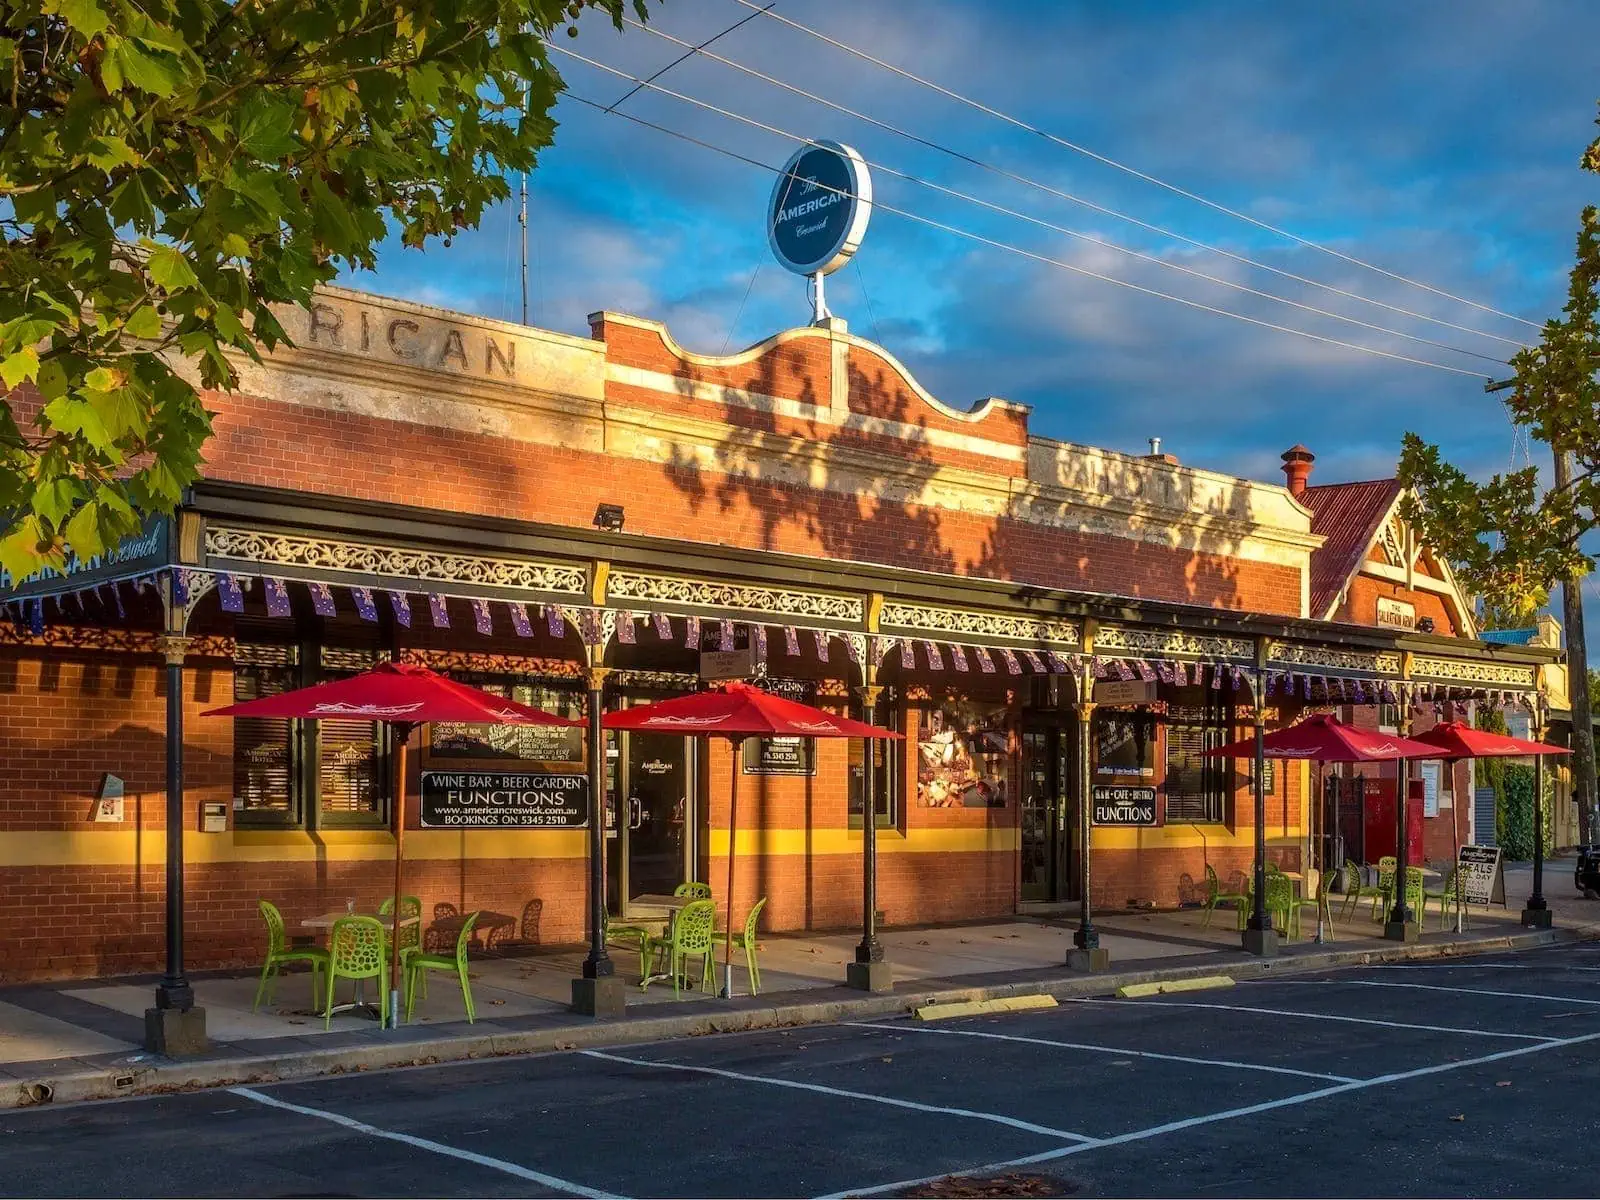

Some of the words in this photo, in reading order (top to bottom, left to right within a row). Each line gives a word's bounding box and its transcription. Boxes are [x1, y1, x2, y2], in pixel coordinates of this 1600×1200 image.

[778, 188, 848, 224] AMERICAN
[703, 629, 748, 641] AMEAN
[641, 762, 673, 770] AMERICAN
[432, 776, 466, 788] WINE
[468, 776, 492, 788] BAR
[502, 777, 530, 789] BEER
[532, 777, 581, 790] GARDEN
[447, 791, 565, 806] FUNCTIONS
[1113, 790, 1129, 800] CAFE
[434, 806, 577, 815] www.americancreswick.com.au
[1096, 806, 1152, 821] FUNCTIONS
[444, 815, 498, 825] BOOKINGS
[501, 815, 519, 824] ON
[521, 815, 544, 825] 5345
[545, 815, 567, 825] 2510
[1458, 862, 1493, 874] MEALS
